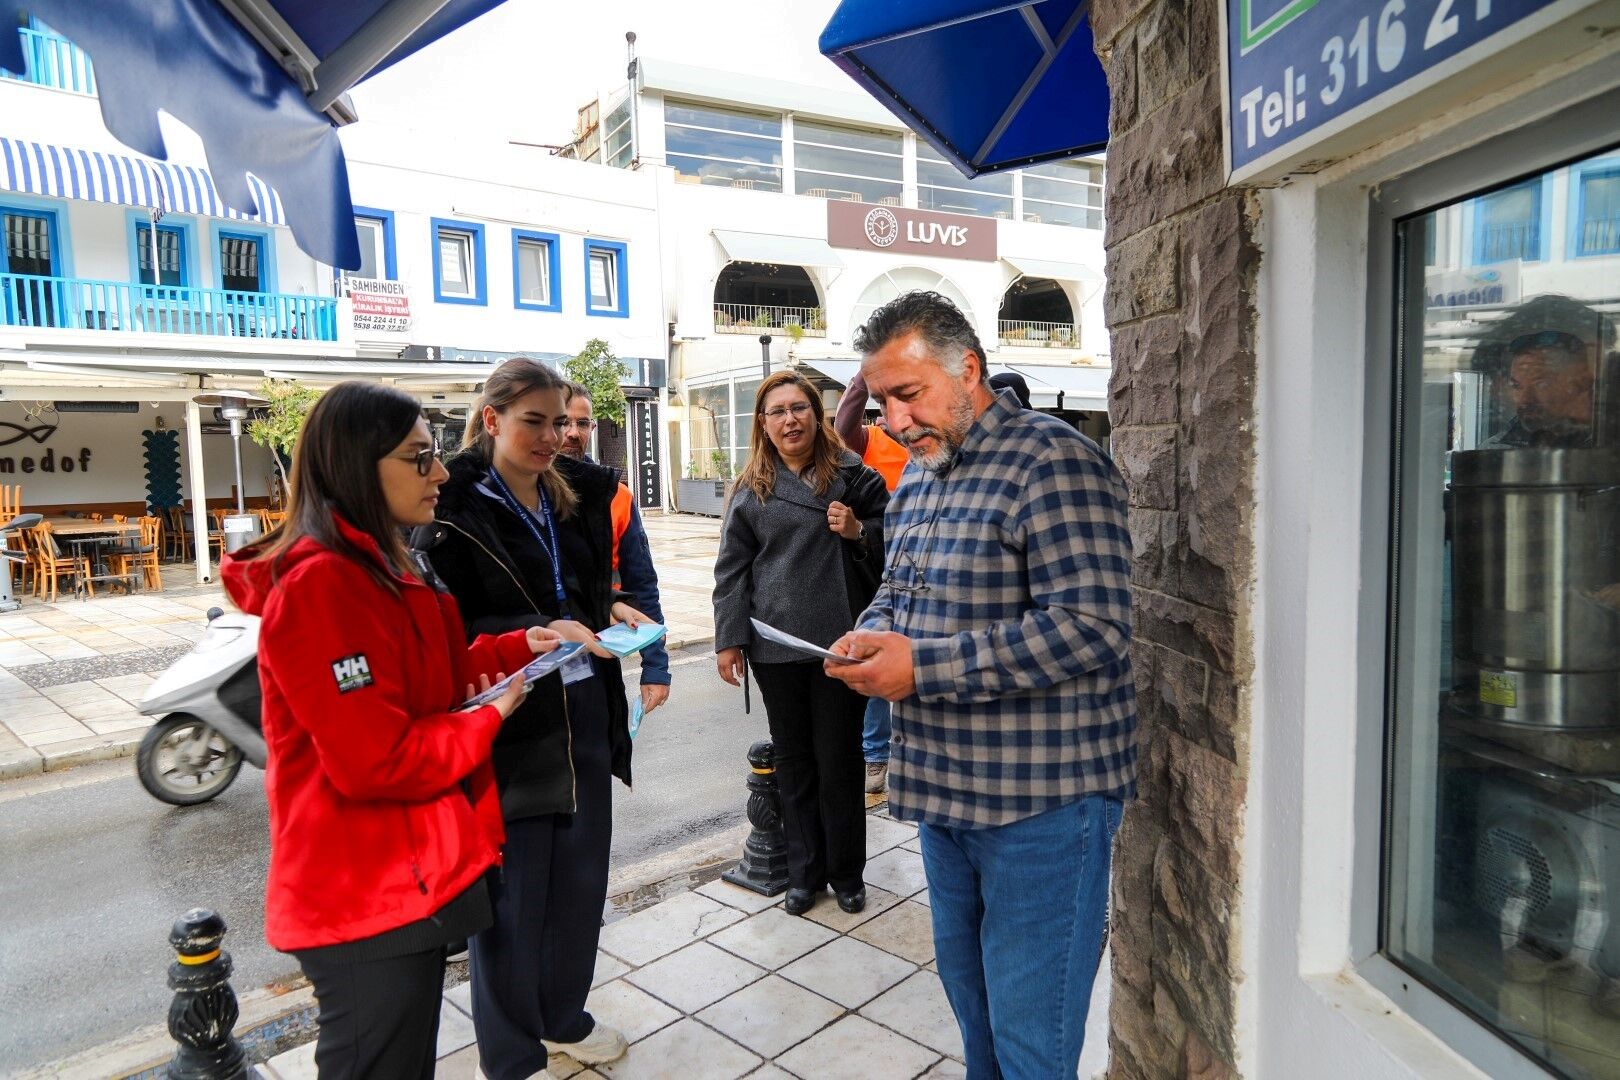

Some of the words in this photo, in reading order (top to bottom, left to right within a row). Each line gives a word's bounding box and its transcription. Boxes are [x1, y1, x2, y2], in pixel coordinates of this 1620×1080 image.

[1240, 65, 1307, 149] Tel:
[1319, 0, 1407, 106] 316
[1423, 0, 1492, 51] 2
[646, 468, 654, 505] SHOP
[333, 655, 369, 681] HH
